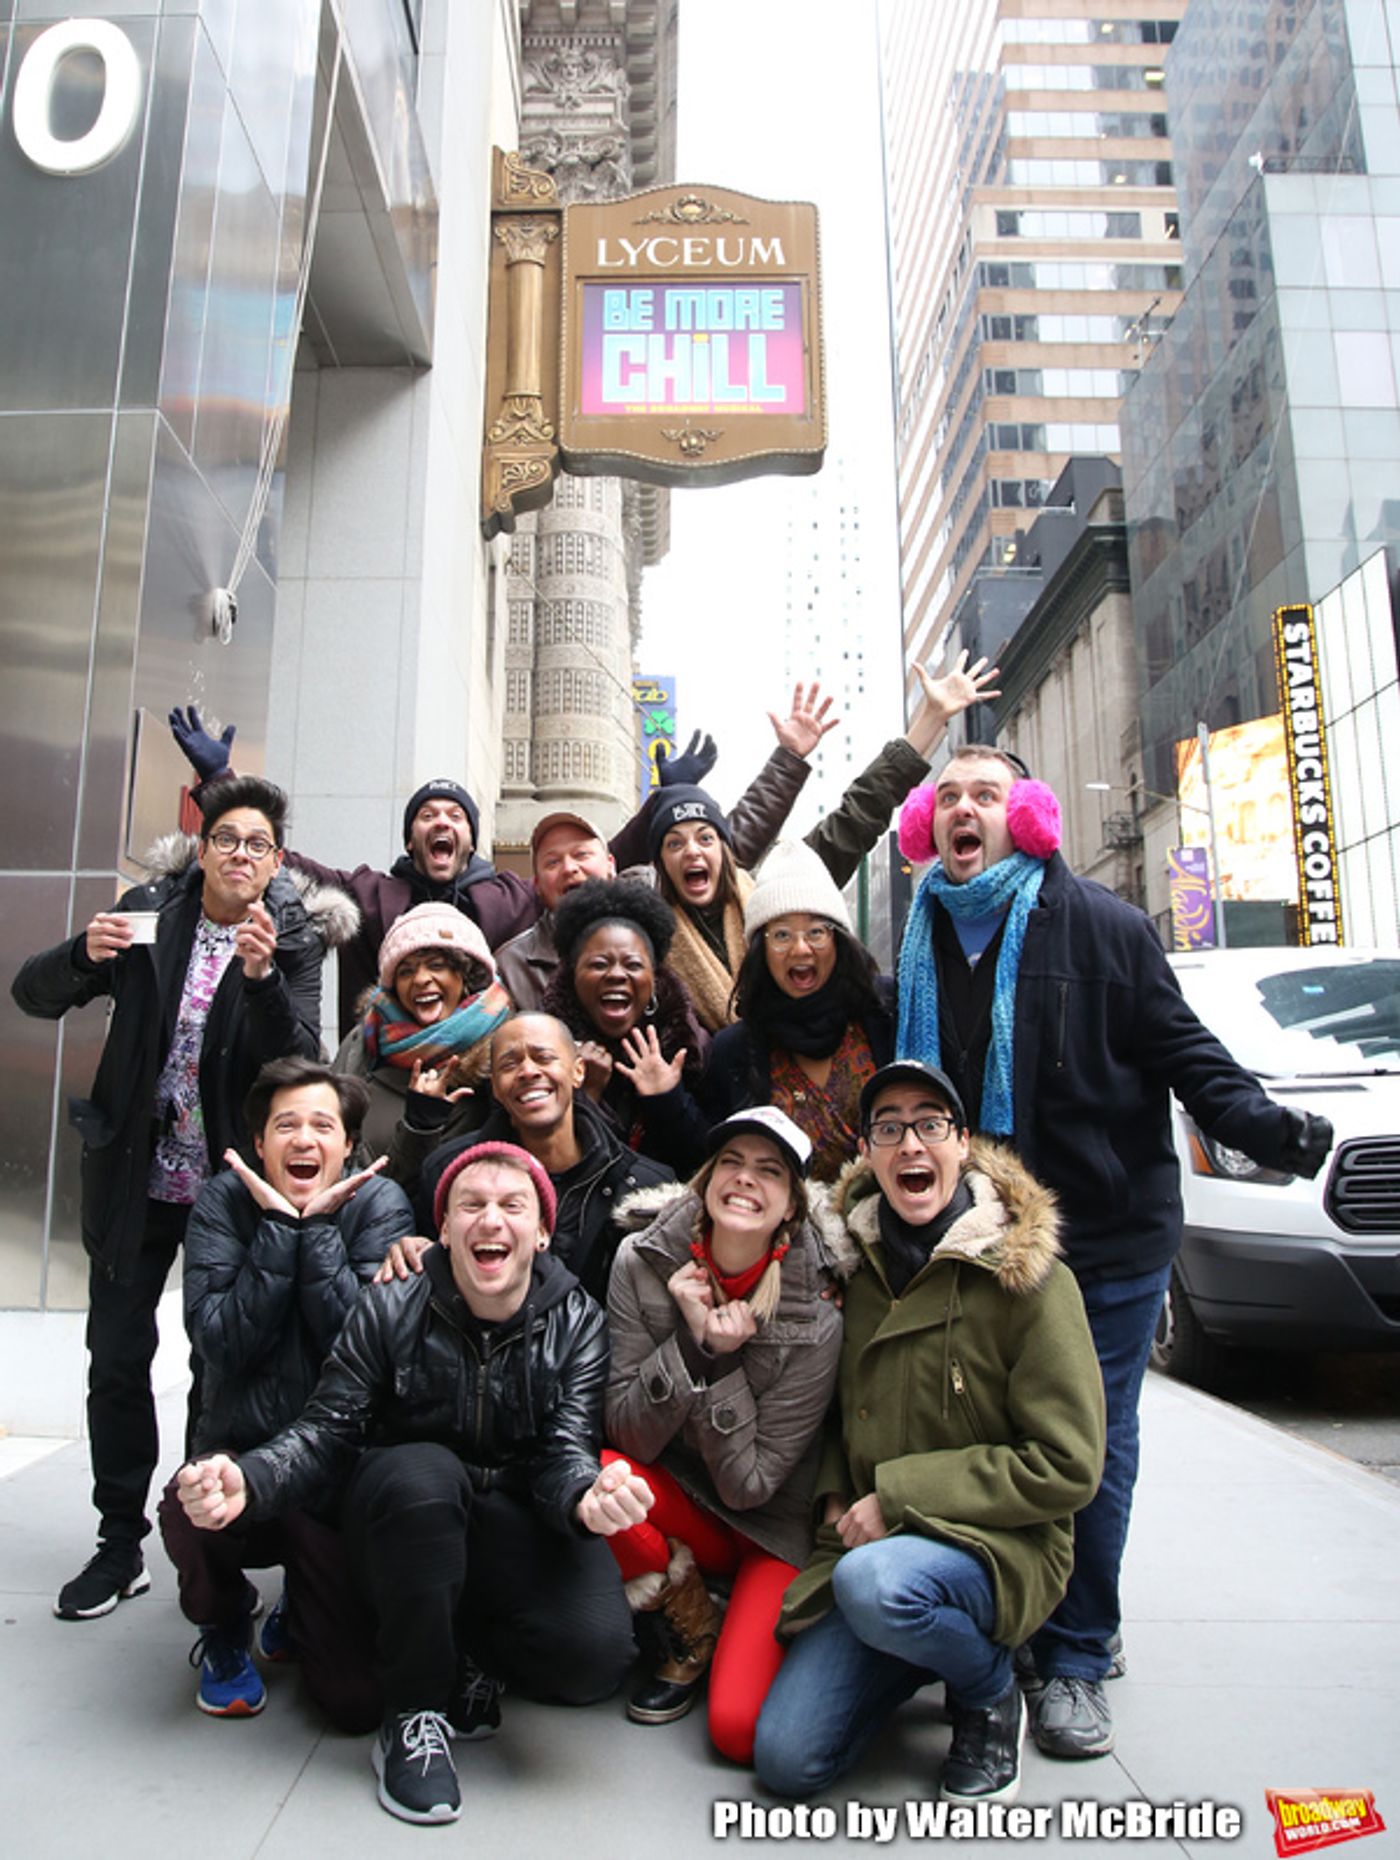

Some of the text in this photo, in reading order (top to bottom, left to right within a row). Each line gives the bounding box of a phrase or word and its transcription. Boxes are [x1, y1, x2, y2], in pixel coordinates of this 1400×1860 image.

[597, 237, 787, 267] LYCEUM
[603, 289, 785, 331] BE MORE
[1283, 622, 1327, 825] STARBUCKS
